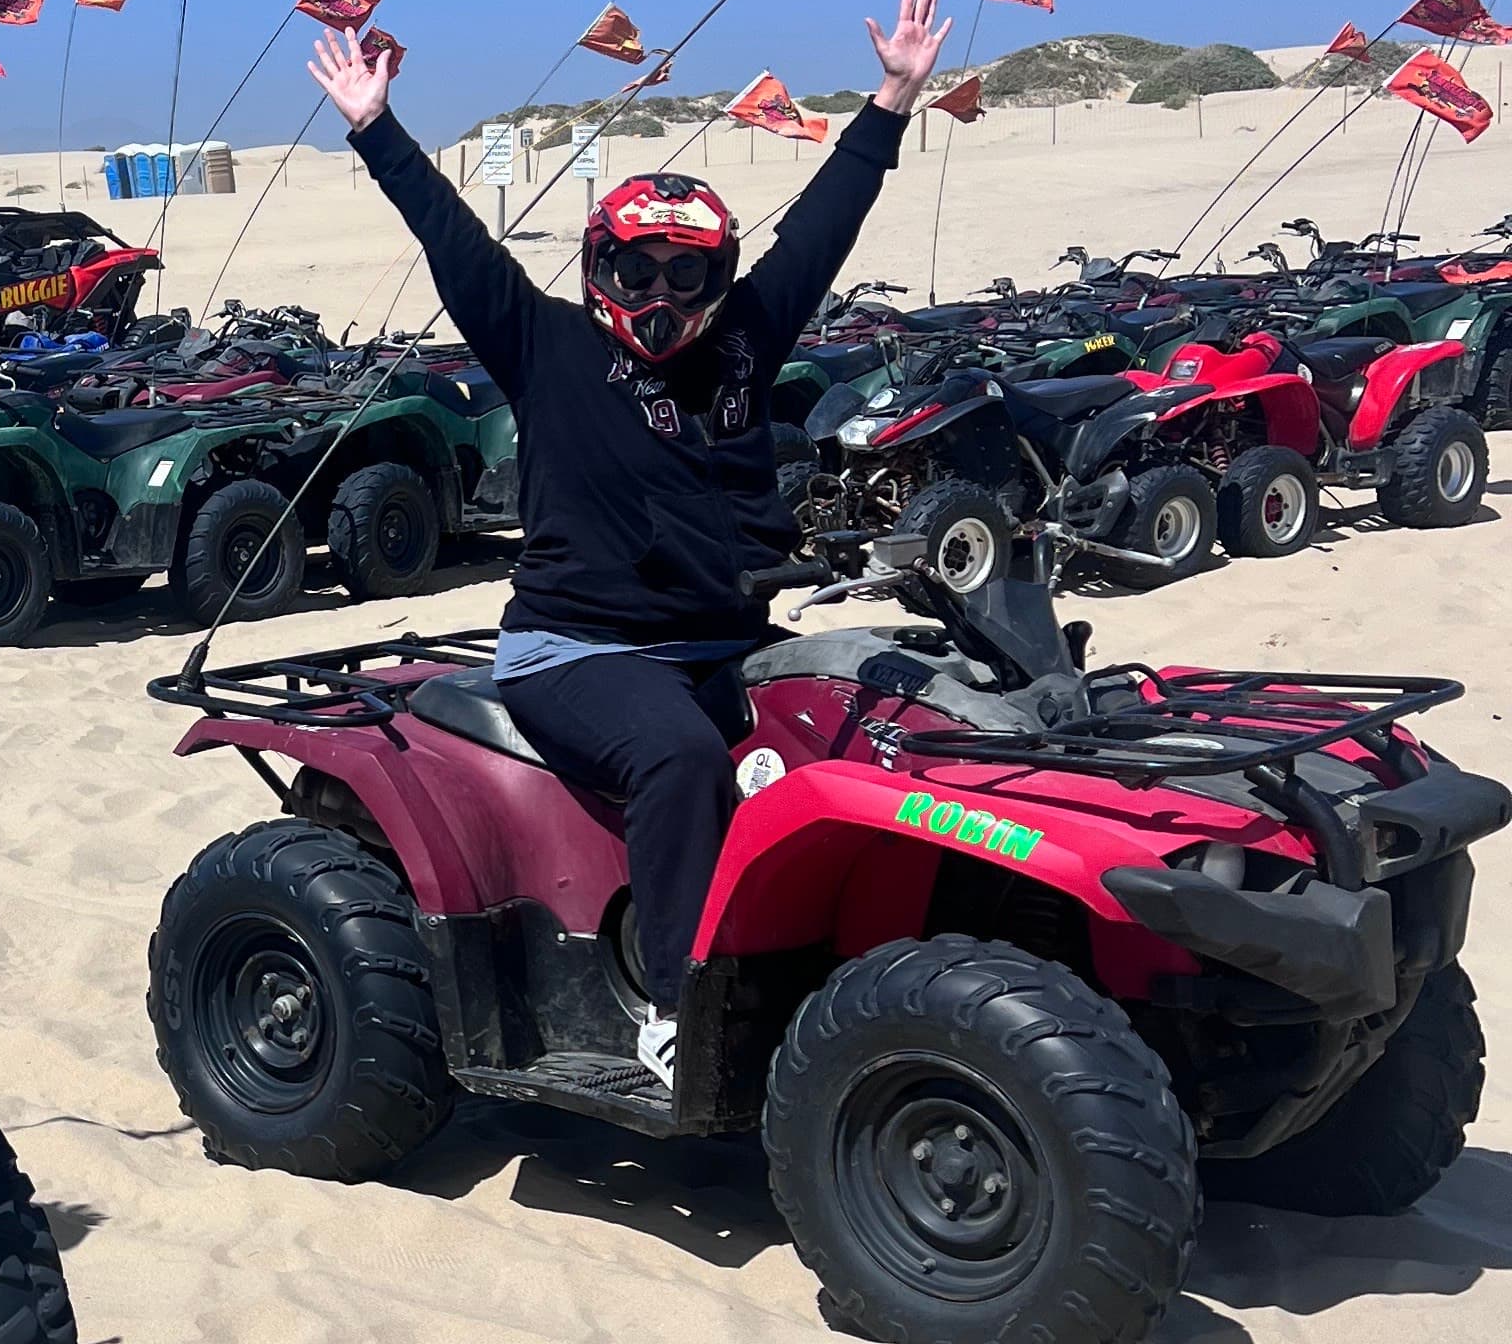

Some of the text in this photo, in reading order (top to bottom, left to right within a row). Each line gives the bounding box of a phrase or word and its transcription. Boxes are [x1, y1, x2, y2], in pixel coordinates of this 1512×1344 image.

[0, 274, 67, 308] BUGGIE
[755, 752, 772, 768] QL
[895, 792, 1045, 862] ROBIN
